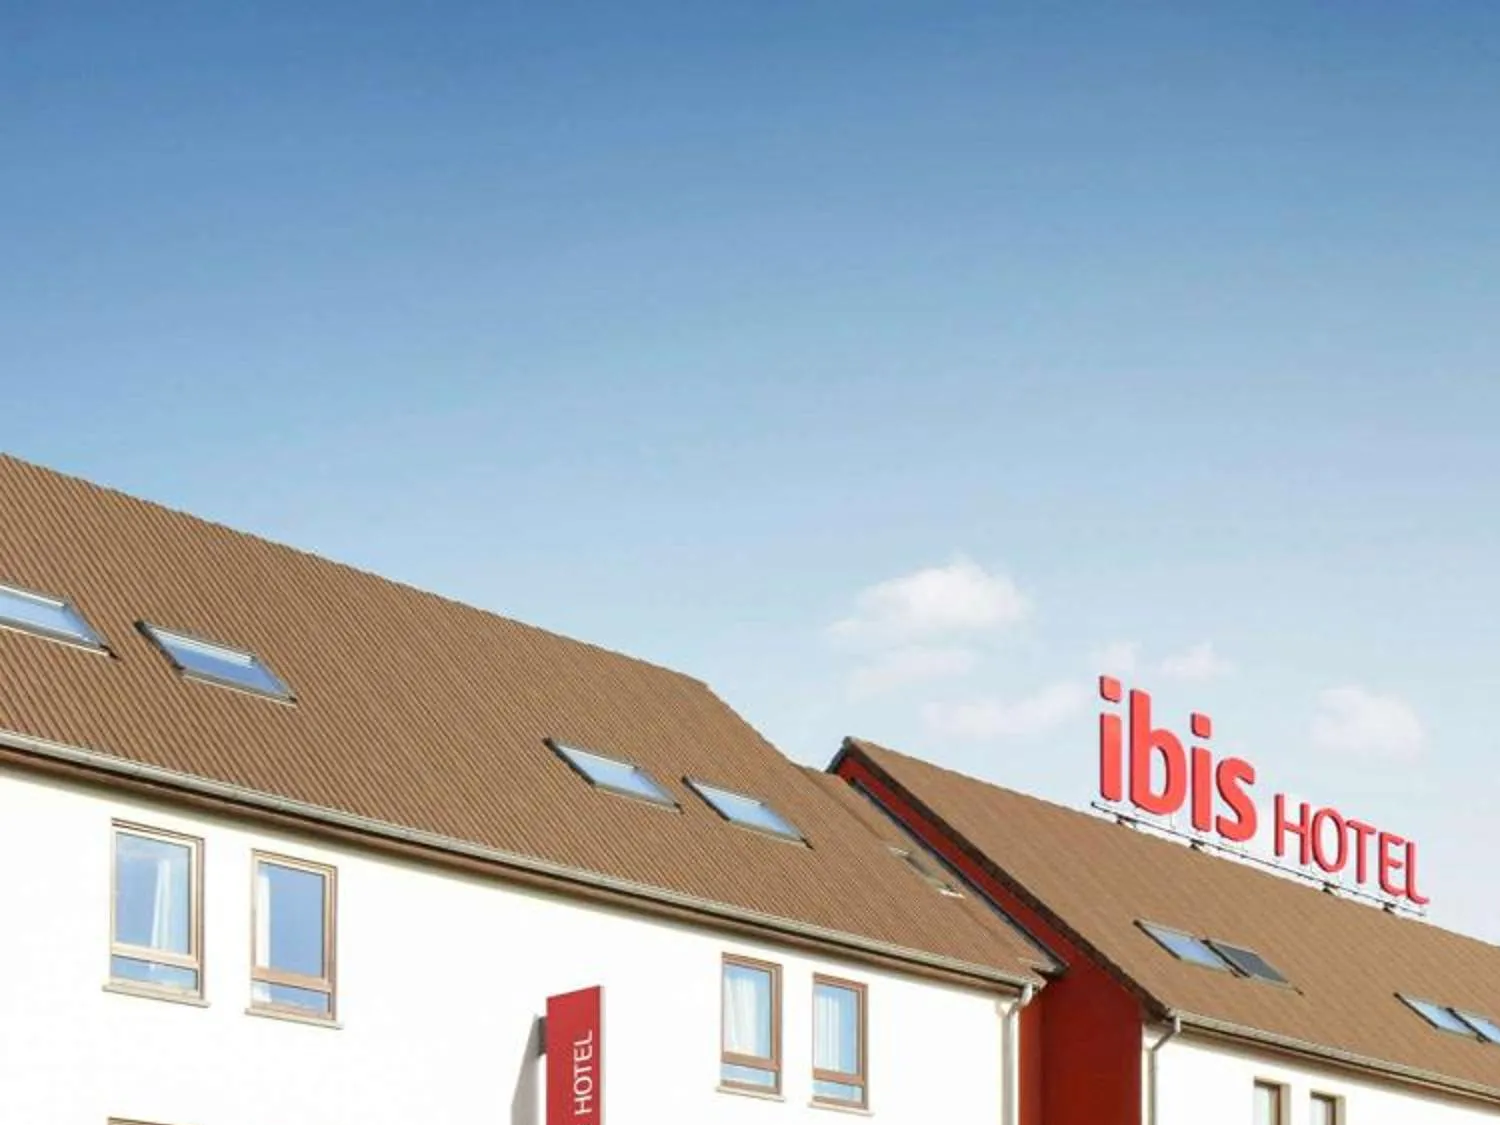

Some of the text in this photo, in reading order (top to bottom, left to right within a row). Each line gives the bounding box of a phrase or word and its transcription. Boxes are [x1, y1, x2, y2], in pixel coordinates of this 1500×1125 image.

[1099, 674, 1430, 904] ibis HOTEL
[573, 1028, 593, 1116] HOTEL
